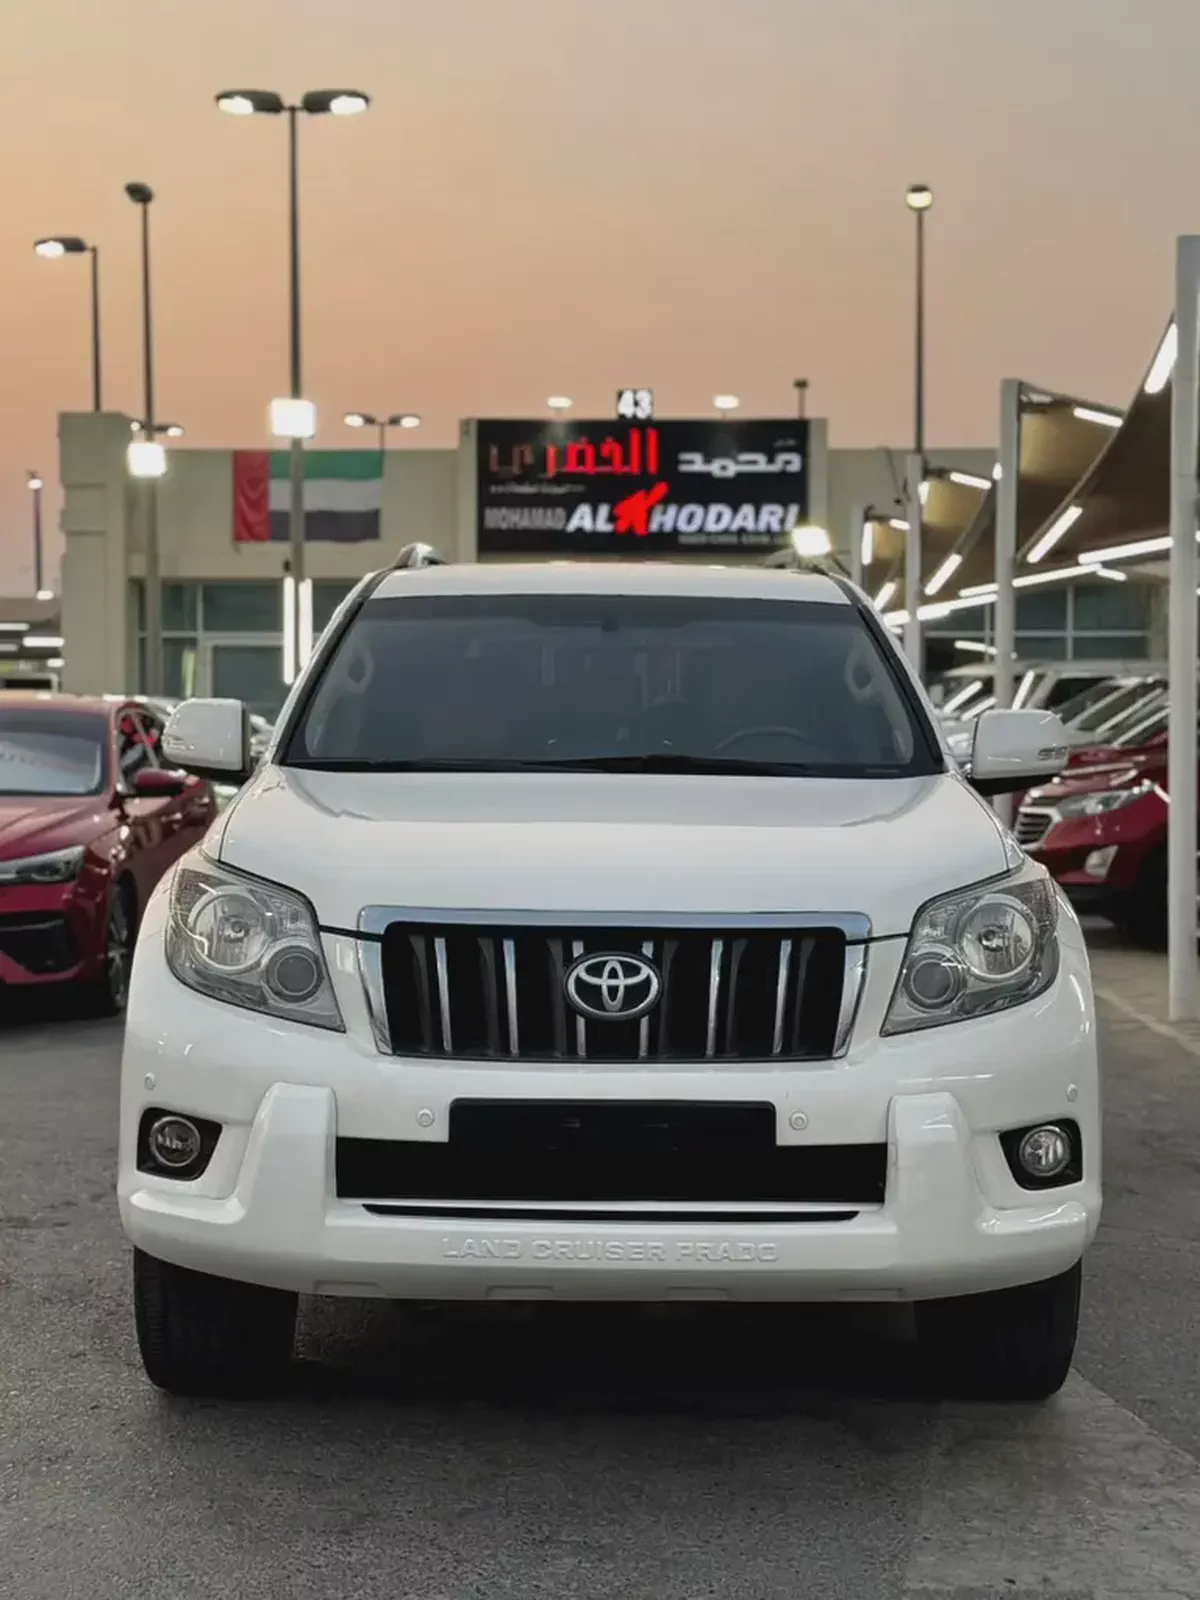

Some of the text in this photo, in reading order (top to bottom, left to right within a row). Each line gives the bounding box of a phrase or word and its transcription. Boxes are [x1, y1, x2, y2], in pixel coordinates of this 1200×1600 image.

[618, 389, 652, 419] 43
[488, 427, 802, 480] محمد الخضري
[442, 1238, 779, 1263] LAND CRUISER PRADO
